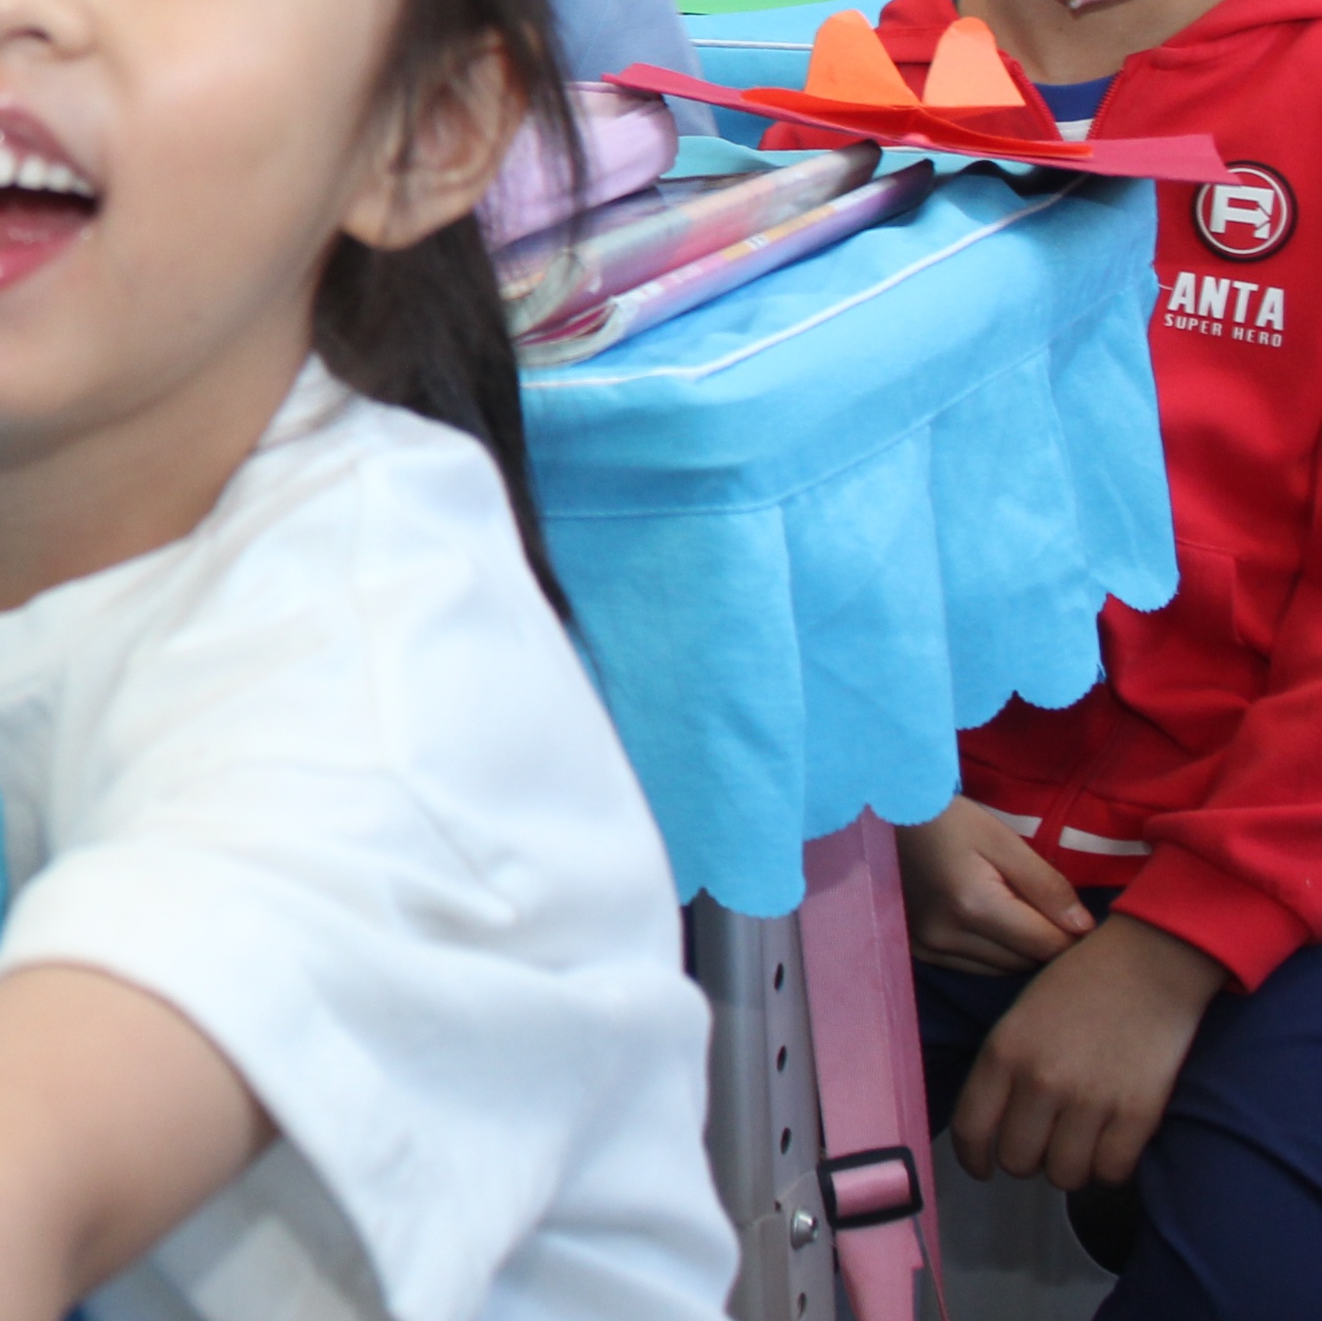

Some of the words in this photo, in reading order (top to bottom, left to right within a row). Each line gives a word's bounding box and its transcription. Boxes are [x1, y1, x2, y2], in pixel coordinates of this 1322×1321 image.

[1167, 271, 1285, 331] ANTA
[1164, 313, 1223, 337] SUPER
[1232, 326, 1283, 348] HERO
